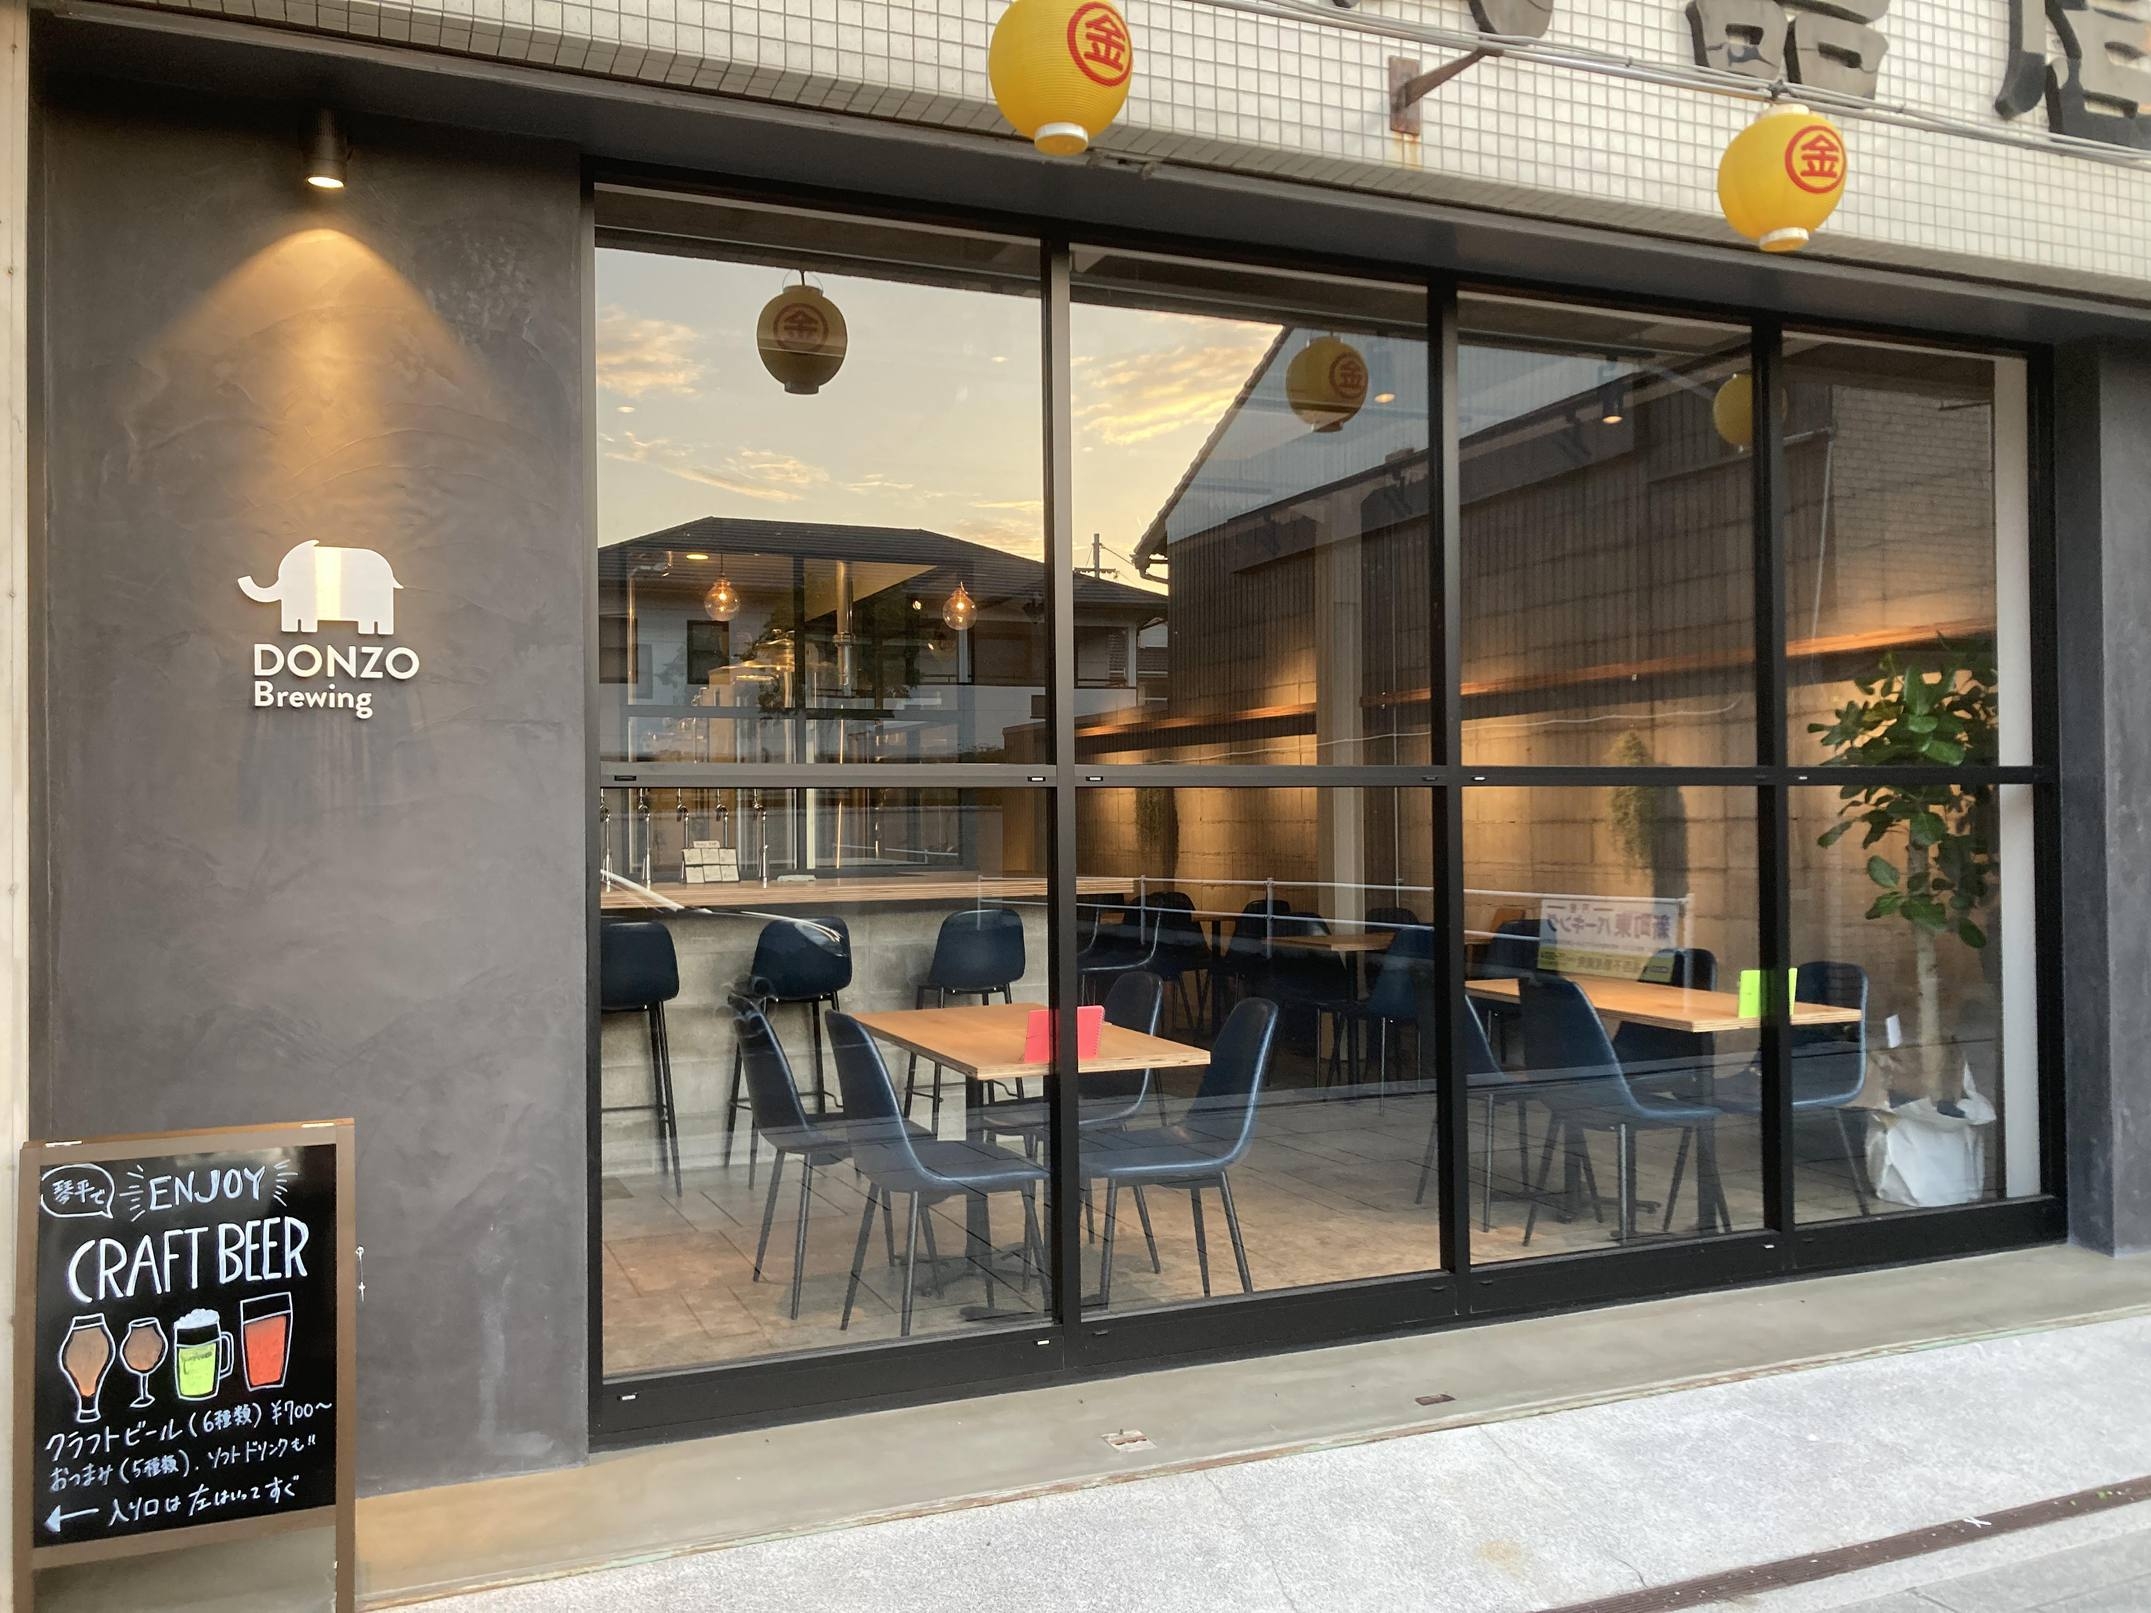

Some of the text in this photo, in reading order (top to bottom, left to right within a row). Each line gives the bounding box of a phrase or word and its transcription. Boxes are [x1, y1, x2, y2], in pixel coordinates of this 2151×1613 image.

[1084, 14, 1127, 72] 金
[1800, 134, 1839, 178] 金
[253, 643, 420, 680] DONZO
[254, 680, 373, 719] Brewing
[52, 1178, 105, 1205] 琴平で
[149, 1166, 266, 1211] ENJOY
[67, 1215, 309, 1303] CRAFT BEER
